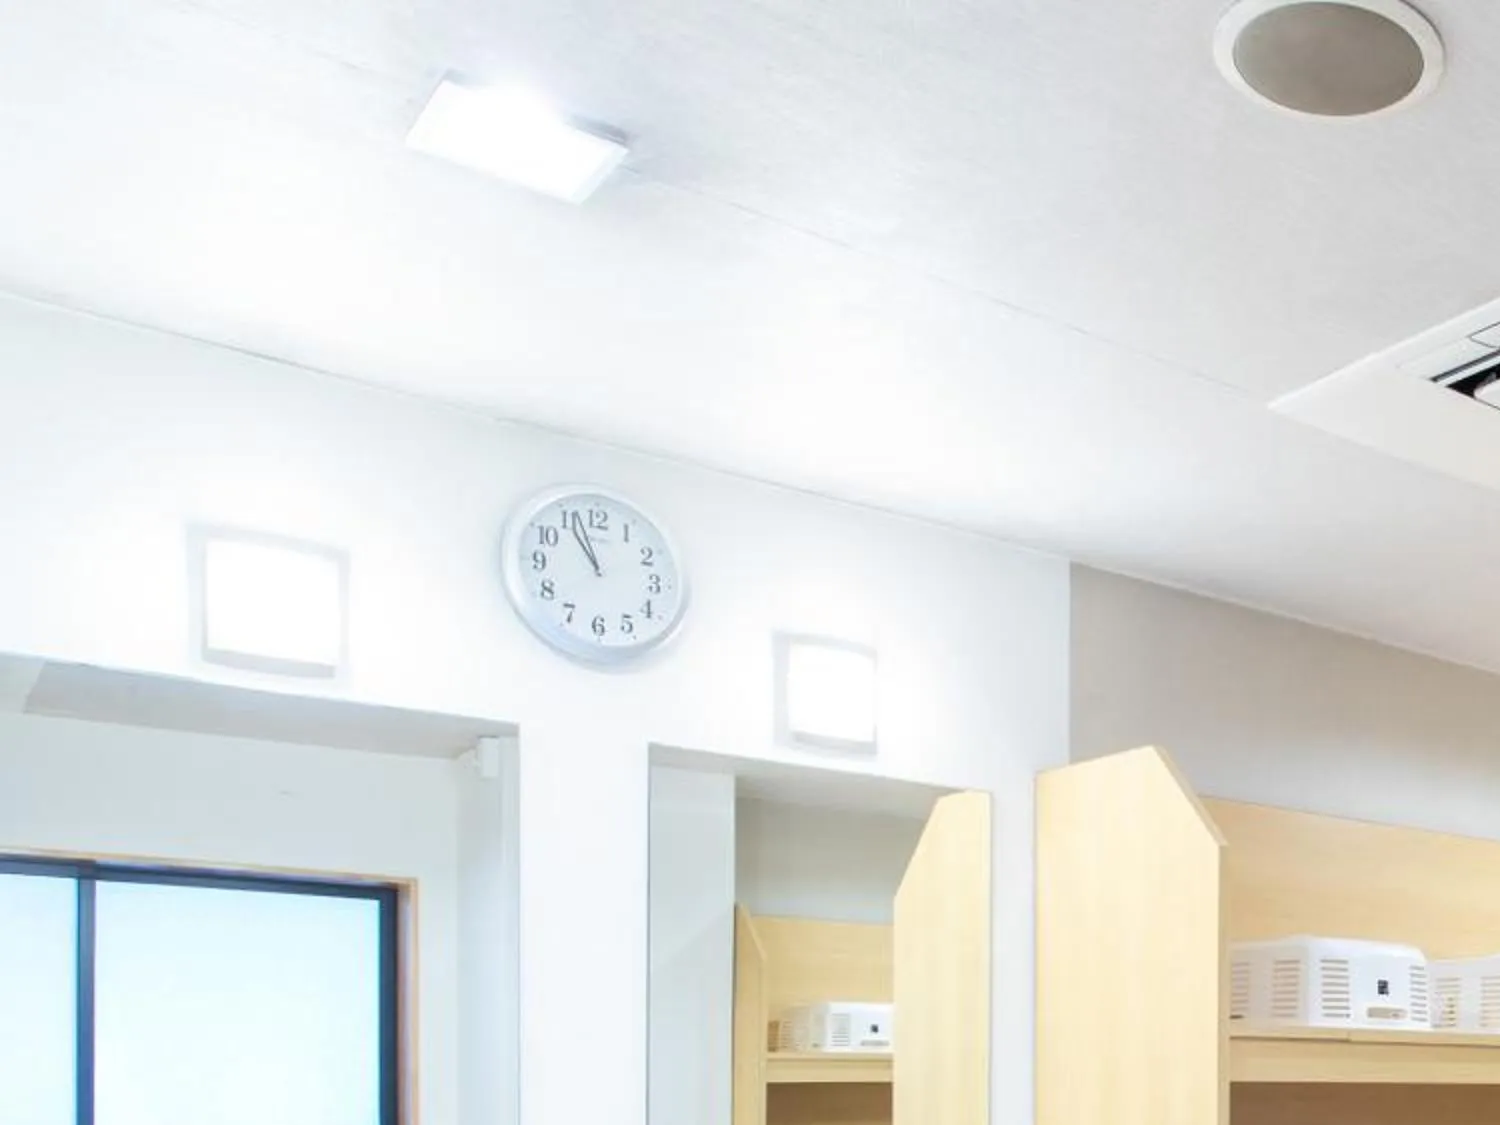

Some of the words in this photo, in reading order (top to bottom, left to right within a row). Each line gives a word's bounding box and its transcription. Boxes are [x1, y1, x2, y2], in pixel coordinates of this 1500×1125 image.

[588, 509, 609, 531] 12
[537, 525, 559, 547] 10
[622, 523, 630, 543] 1
[532, 550, 547, 571] 9
[640, 547, 654, 567] 2
[540, 580, 555, 600] 8
[648, 574, 661, 594] 3
[562, 602, 576, 624] 7
[640, 599, 653, 619] 4
[591, 615, 606, 636] 6
[620, 614, 634, 634] 5
